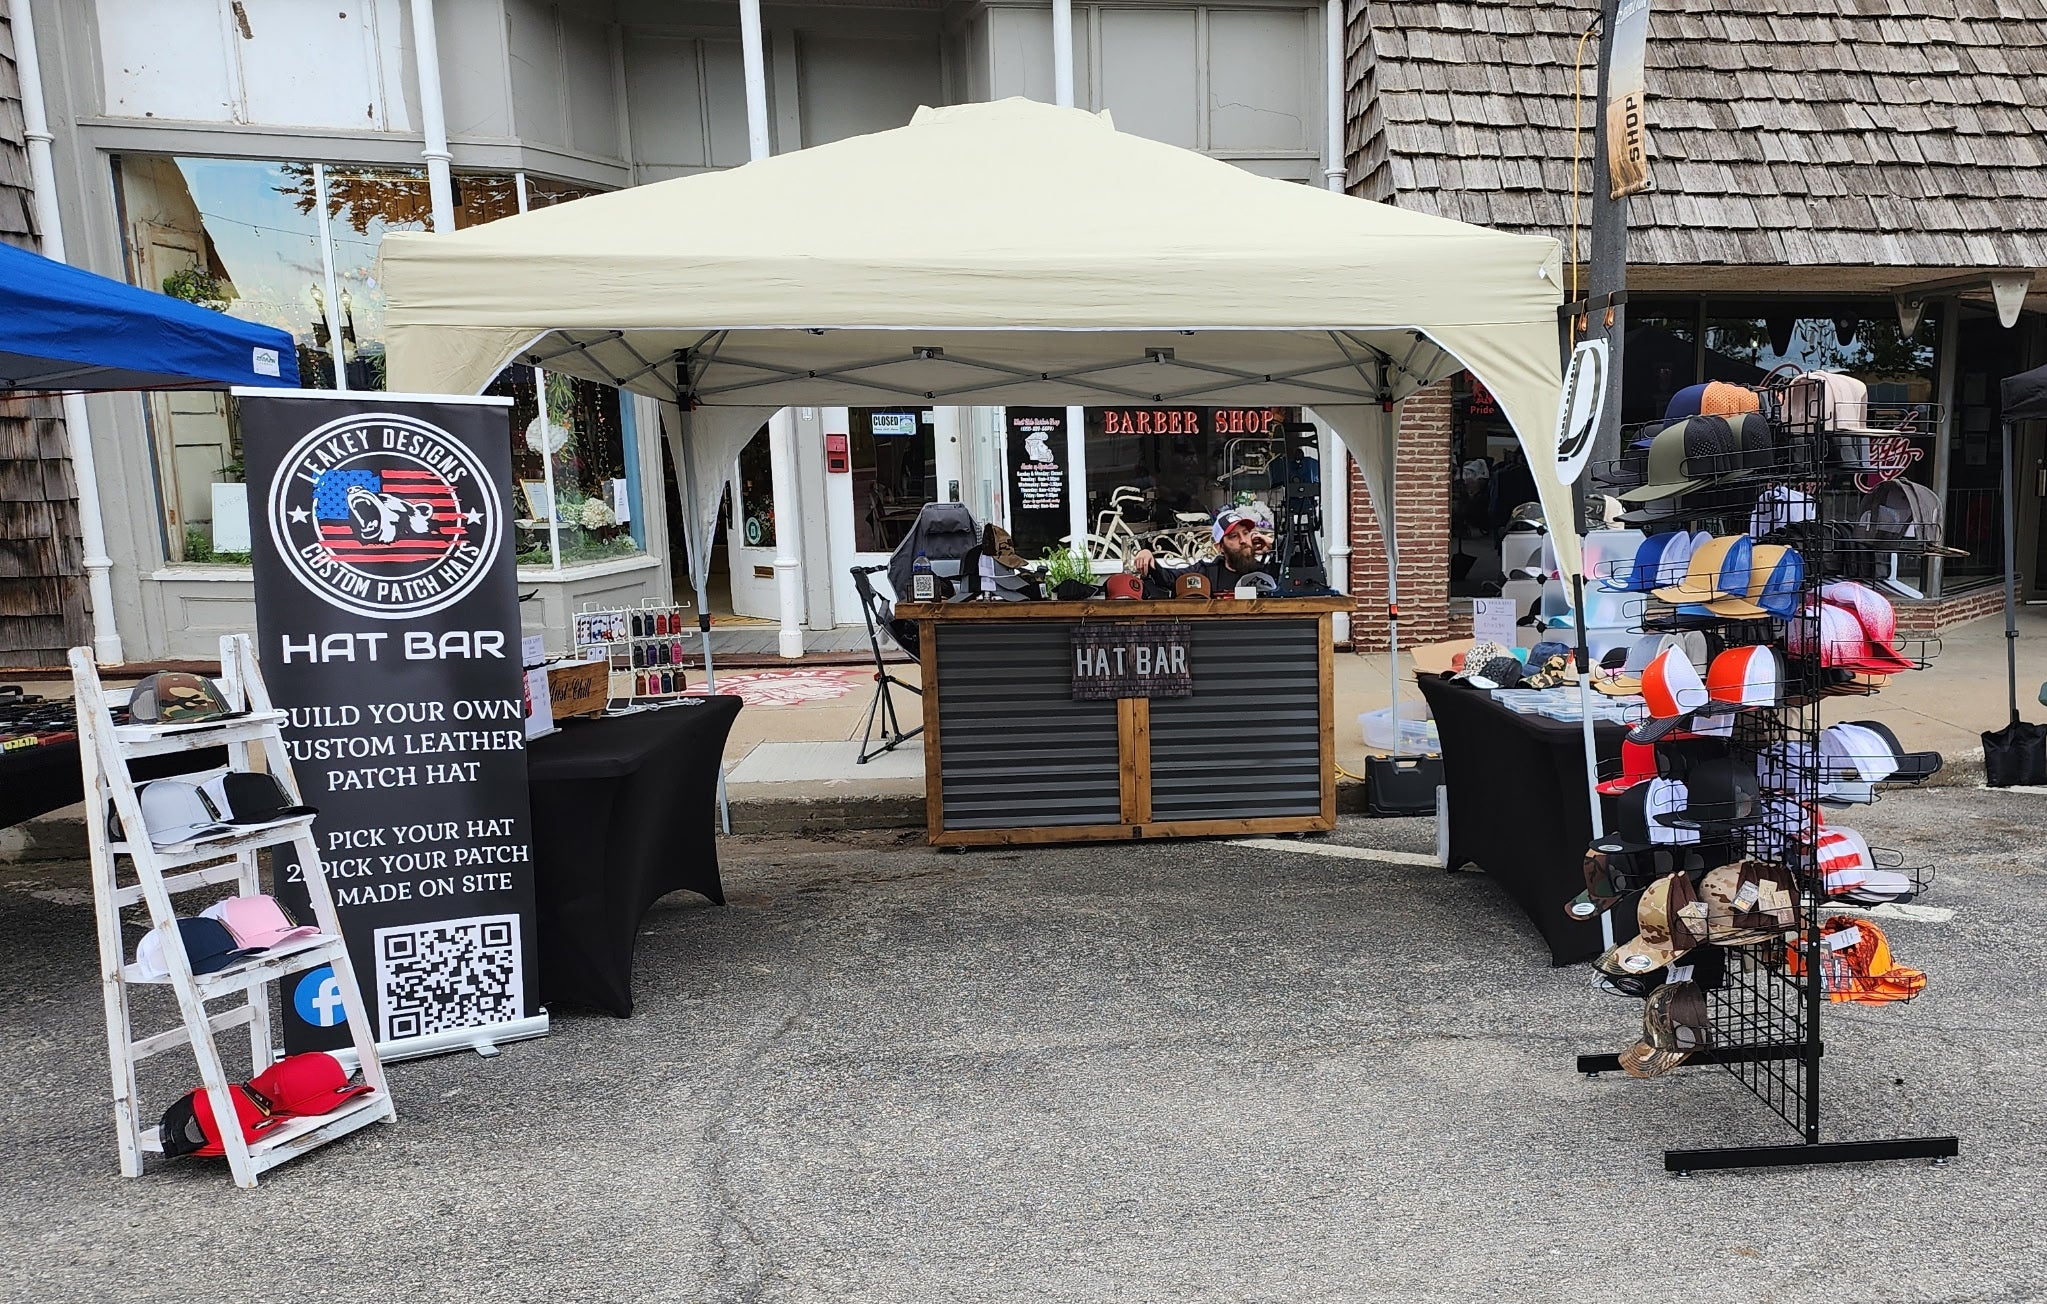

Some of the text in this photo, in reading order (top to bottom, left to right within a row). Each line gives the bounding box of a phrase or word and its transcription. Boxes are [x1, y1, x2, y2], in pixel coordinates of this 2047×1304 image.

[1626, 97, 1640, 162] SHOP
[873, 415, 898, 426] CLOSED
[1104, 410, 1273, 434] BARBER SHOP
[1470, 406, 1494, 414] Pride
[297, 428, 468, 485] LEAKEY DESIGNS
[300, 540, 479, 602] CUSTOM PATCH HATS
[282, 630, 506, 663] HAT BAR
[1077, 646, 1186, 676] HAT BAR
[368, 702, 445, 724] YOUR
[453, 699, 522, 720] OWN
[284, 730, 524, 761] USTOM LEATHER
[327, 762, 480, 791] PATCH HAT
[328, 828, 386, 851] PICK
[392, 822, 459, 844] YOUR
[466, 818, 515, 840] HAT
[286, 864, 306, 883] 2.
[380, 850, 447, 874] YOUR
[454, 844, 529, 867] PATCH
[337, 881, 412, 907] MADE
[419, 877, 454, 898] ON
[462, 873, 513, 893] SITE
